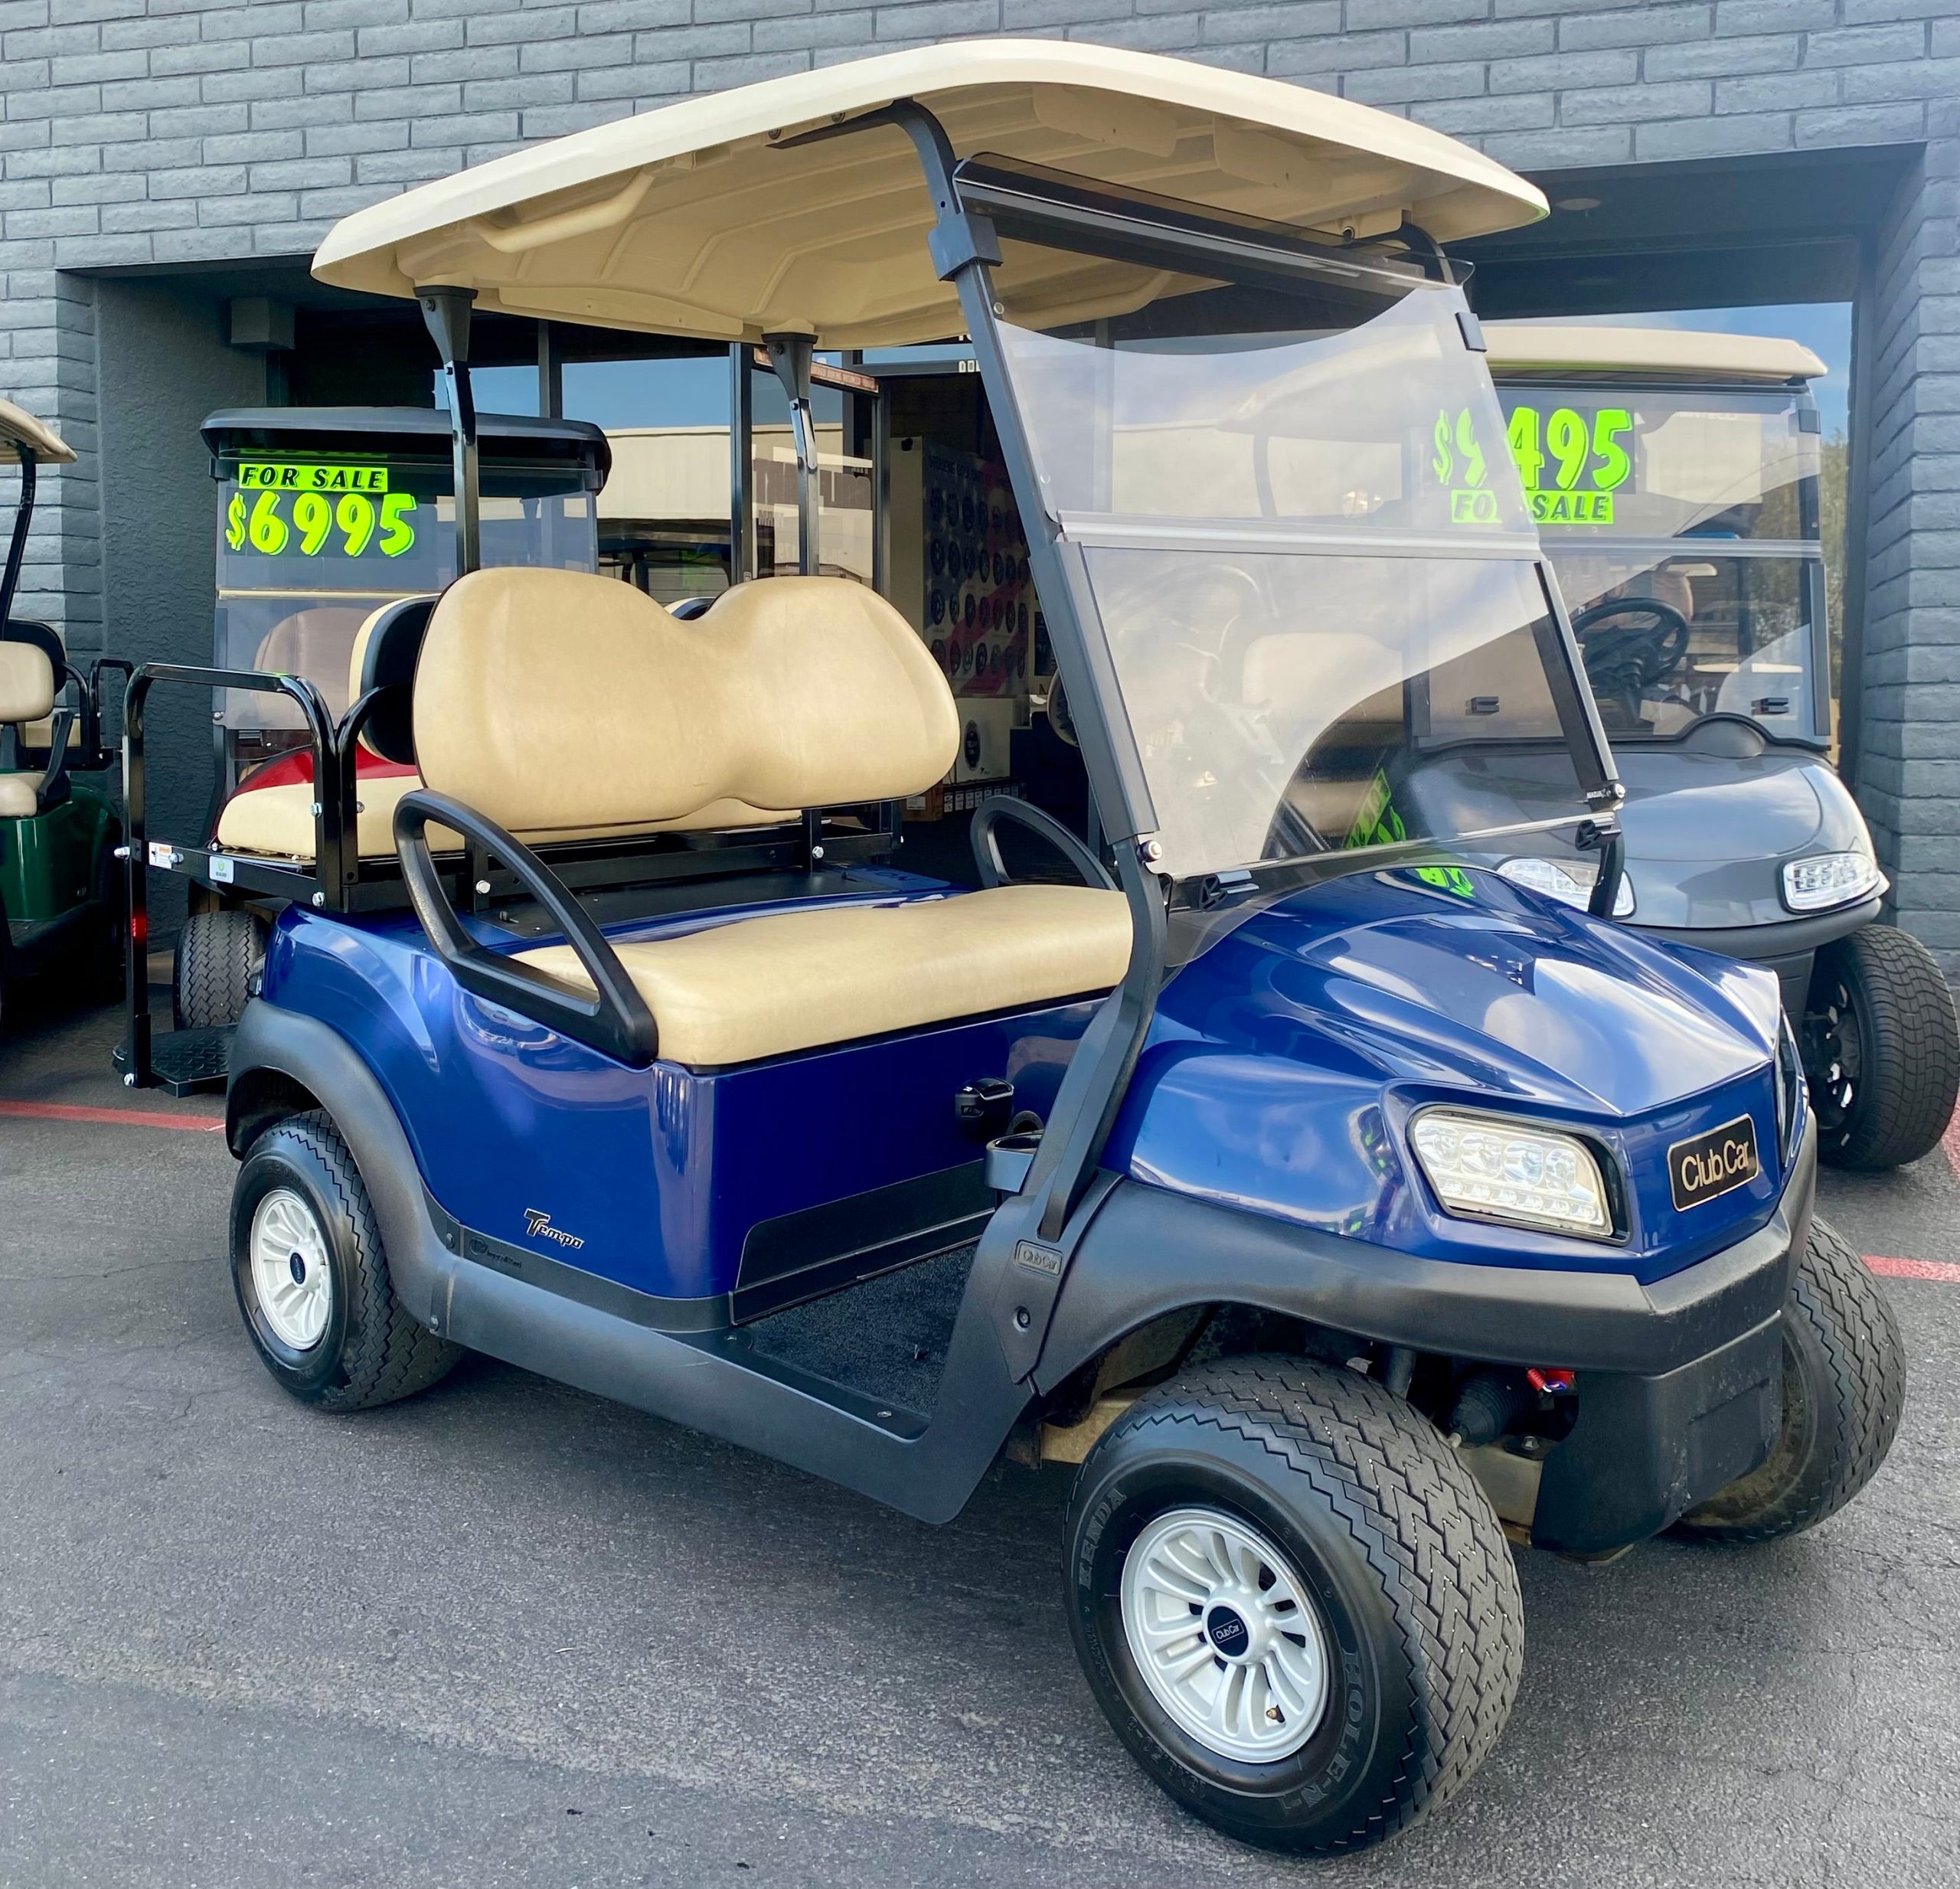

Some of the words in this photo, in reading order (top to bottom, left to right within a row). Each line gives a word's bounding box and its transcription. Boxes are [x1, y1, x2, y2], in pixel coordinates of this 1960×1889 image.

[242, 466, 299, 488] FOR
[312, 468, 384, 489] SALE
[1454, 494, 1498, 520] FO
[1531, 494, 1608, 521] SALE
[225, 490, 417, 557] $6995
[1681, 1149, 1723, 1191] Club
[1723, 1139, 1749, 1175] Car
[524, 1208, 584, 1250] Tempo
[1023, 1249, 1041, 1266] Club
[1042, 1256, 1057, 1270] Car
[1216, 1628, 1230, 1640] Club
